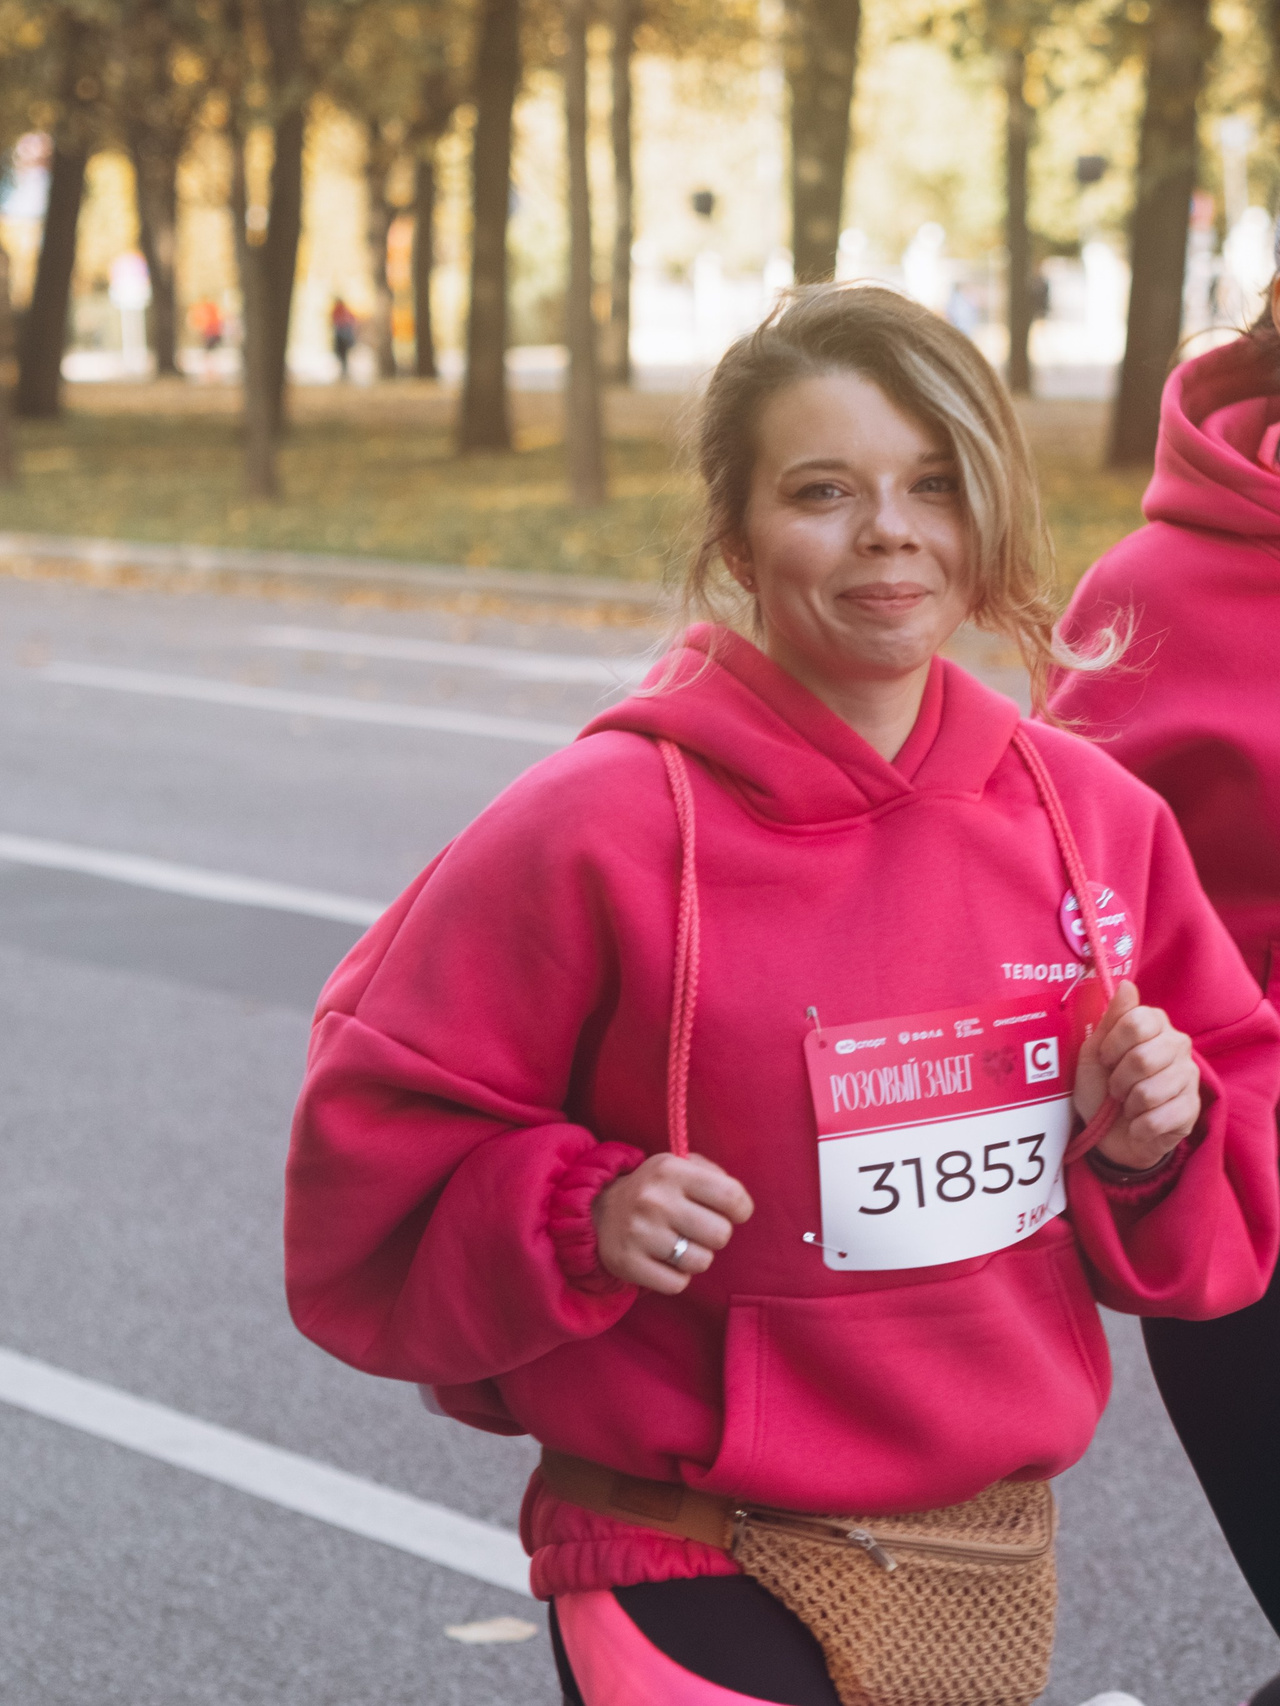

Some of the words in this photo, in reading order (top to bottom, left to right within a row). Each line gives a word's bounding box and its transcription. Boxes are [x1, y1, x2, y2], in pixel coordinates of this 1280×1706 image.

[829, 1057, 921, 1113] РОЗОВЫЙ
[921, 1053, 974, 1099] ЗАБЕГ
[857, 1132, 1047, 1216] 31853
[1015, 1212, 1026, 1233] 3
